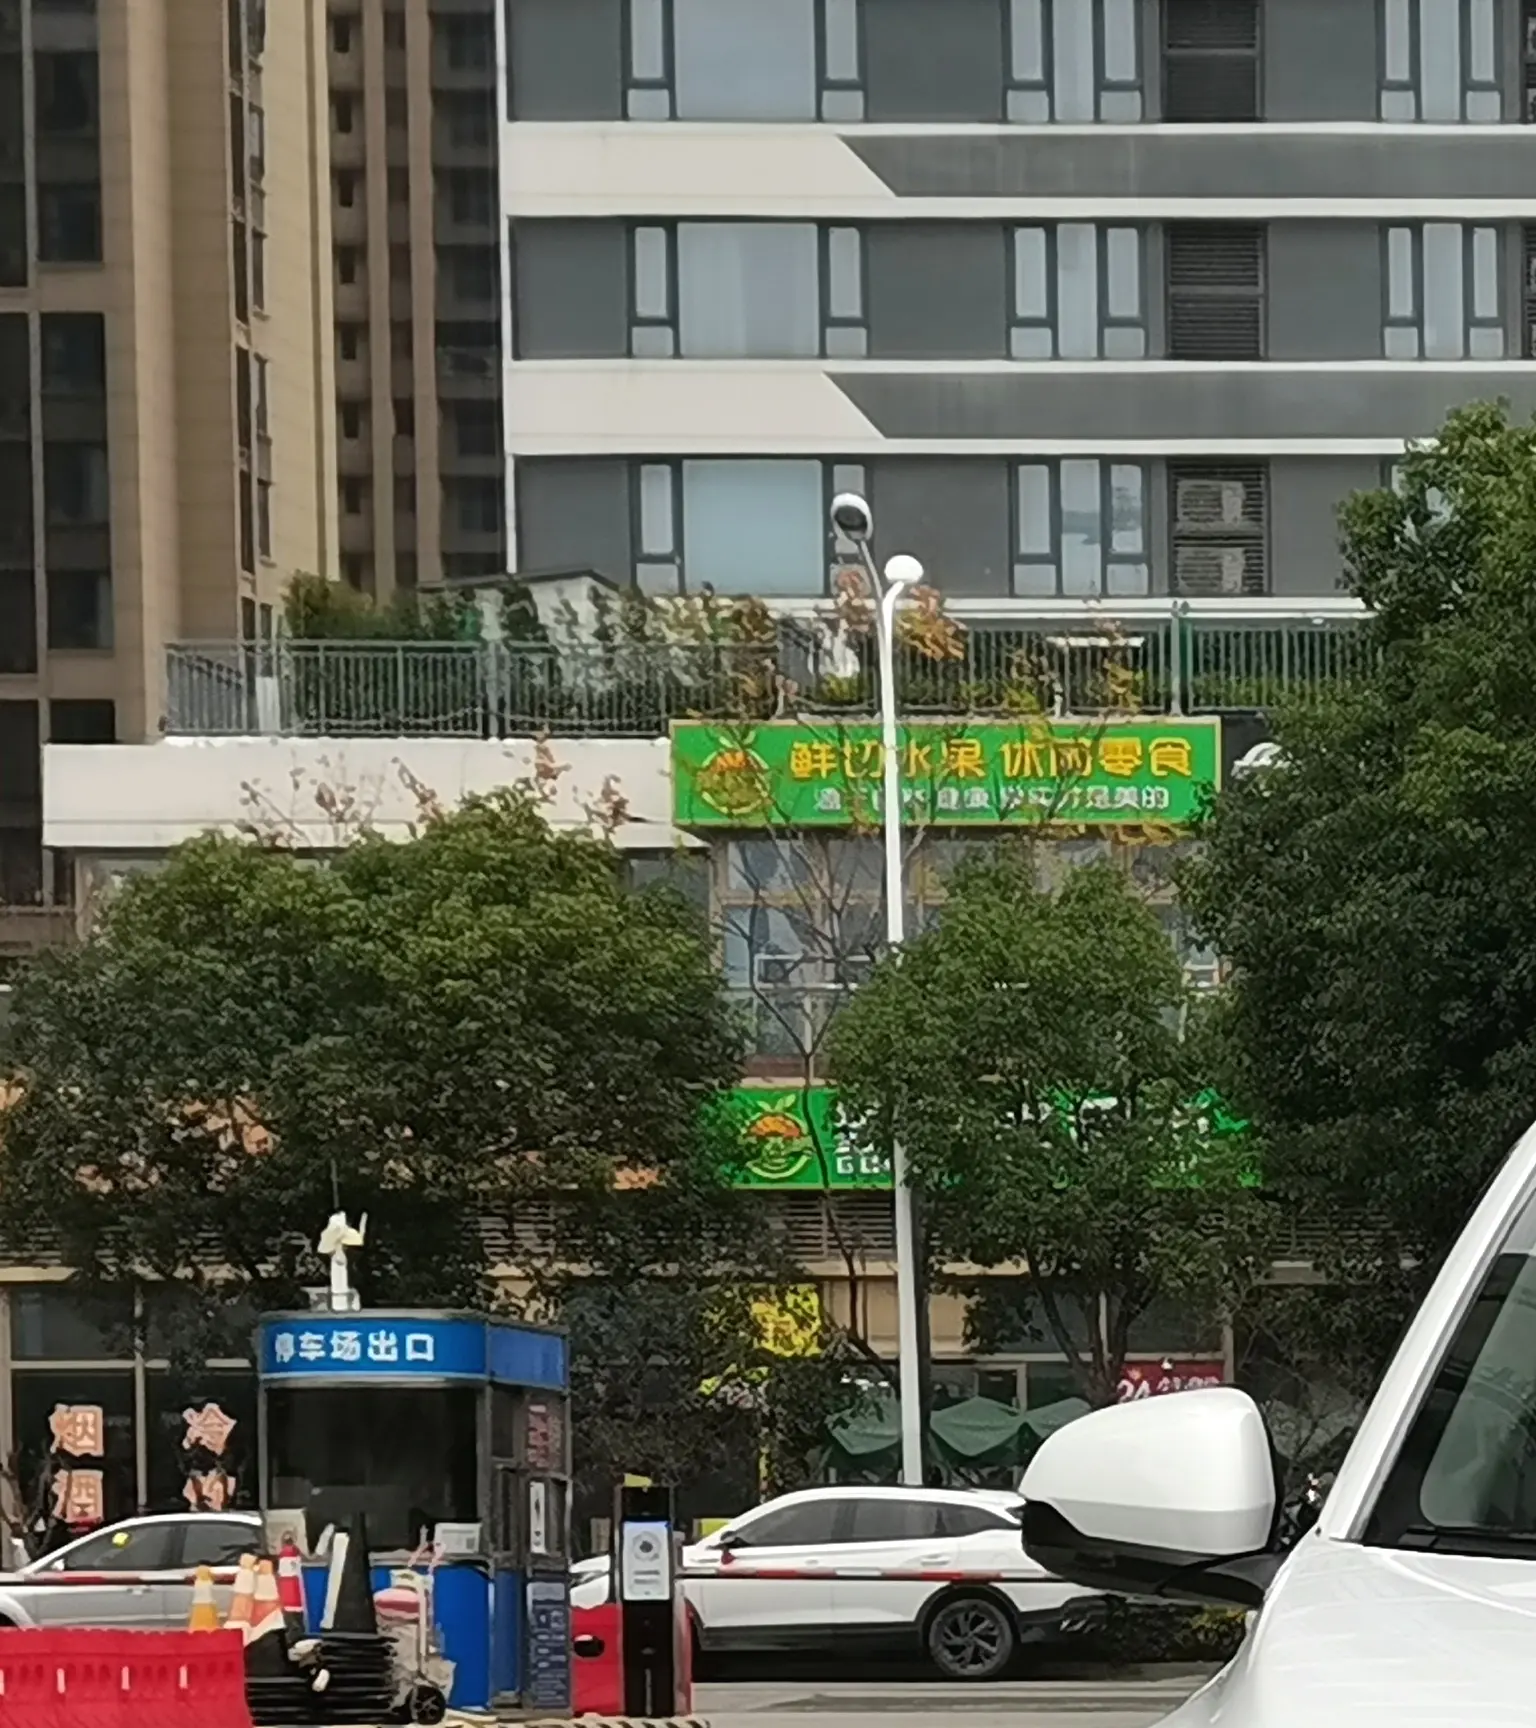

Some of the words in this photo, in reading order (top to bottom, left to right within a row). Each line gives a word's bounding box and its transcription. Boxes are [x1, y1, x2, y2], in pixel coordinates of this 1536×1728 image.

[789, 738, 986, 779] 鲜切水果
[1000, 736, 1192, 778] 休闲零食
[274, 1329, 434, 1363] 停车场出口
